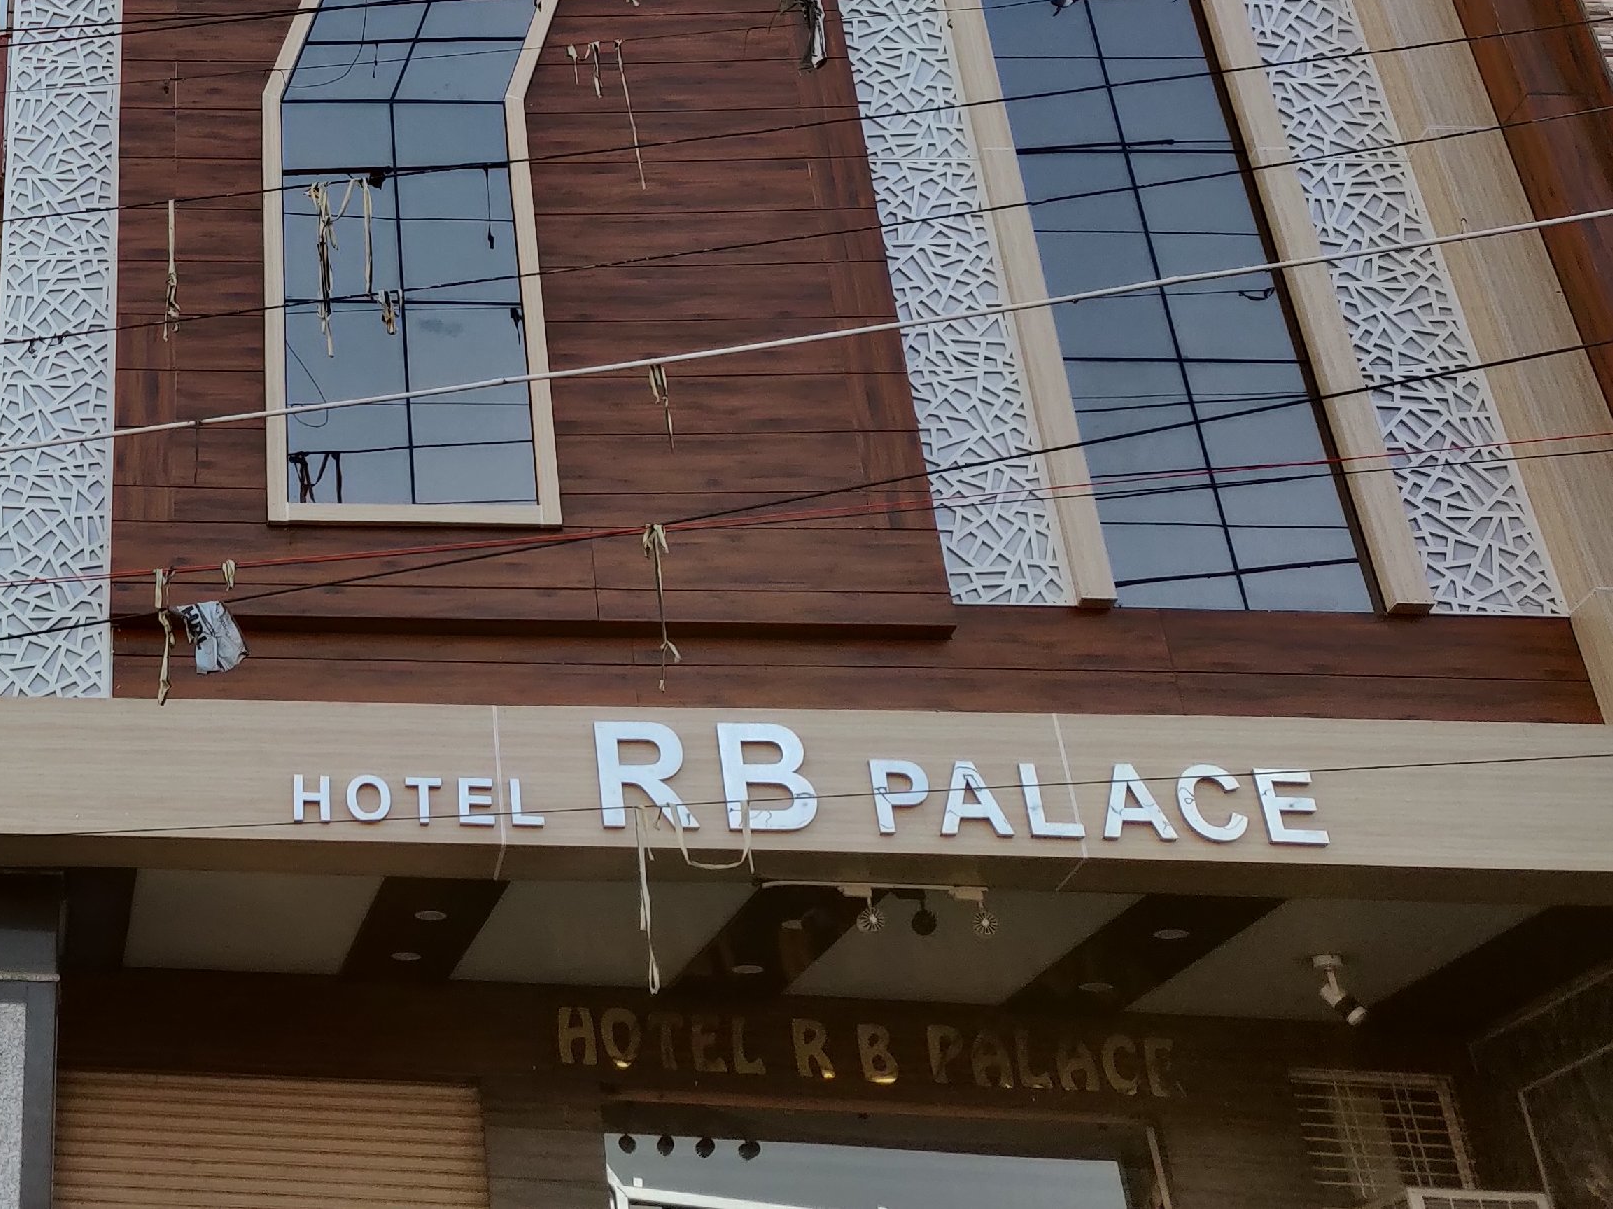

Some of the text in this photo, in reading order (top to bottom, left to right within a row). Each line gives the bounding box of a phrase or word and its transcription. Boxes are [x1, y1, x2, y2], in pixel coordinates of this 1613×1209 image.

[292, 720, 1331, 848] HOTEL RB PALACE
[557, 1006, 766, 1076] HOTEL
[927, 1024, 1178, 1099] PALACE
